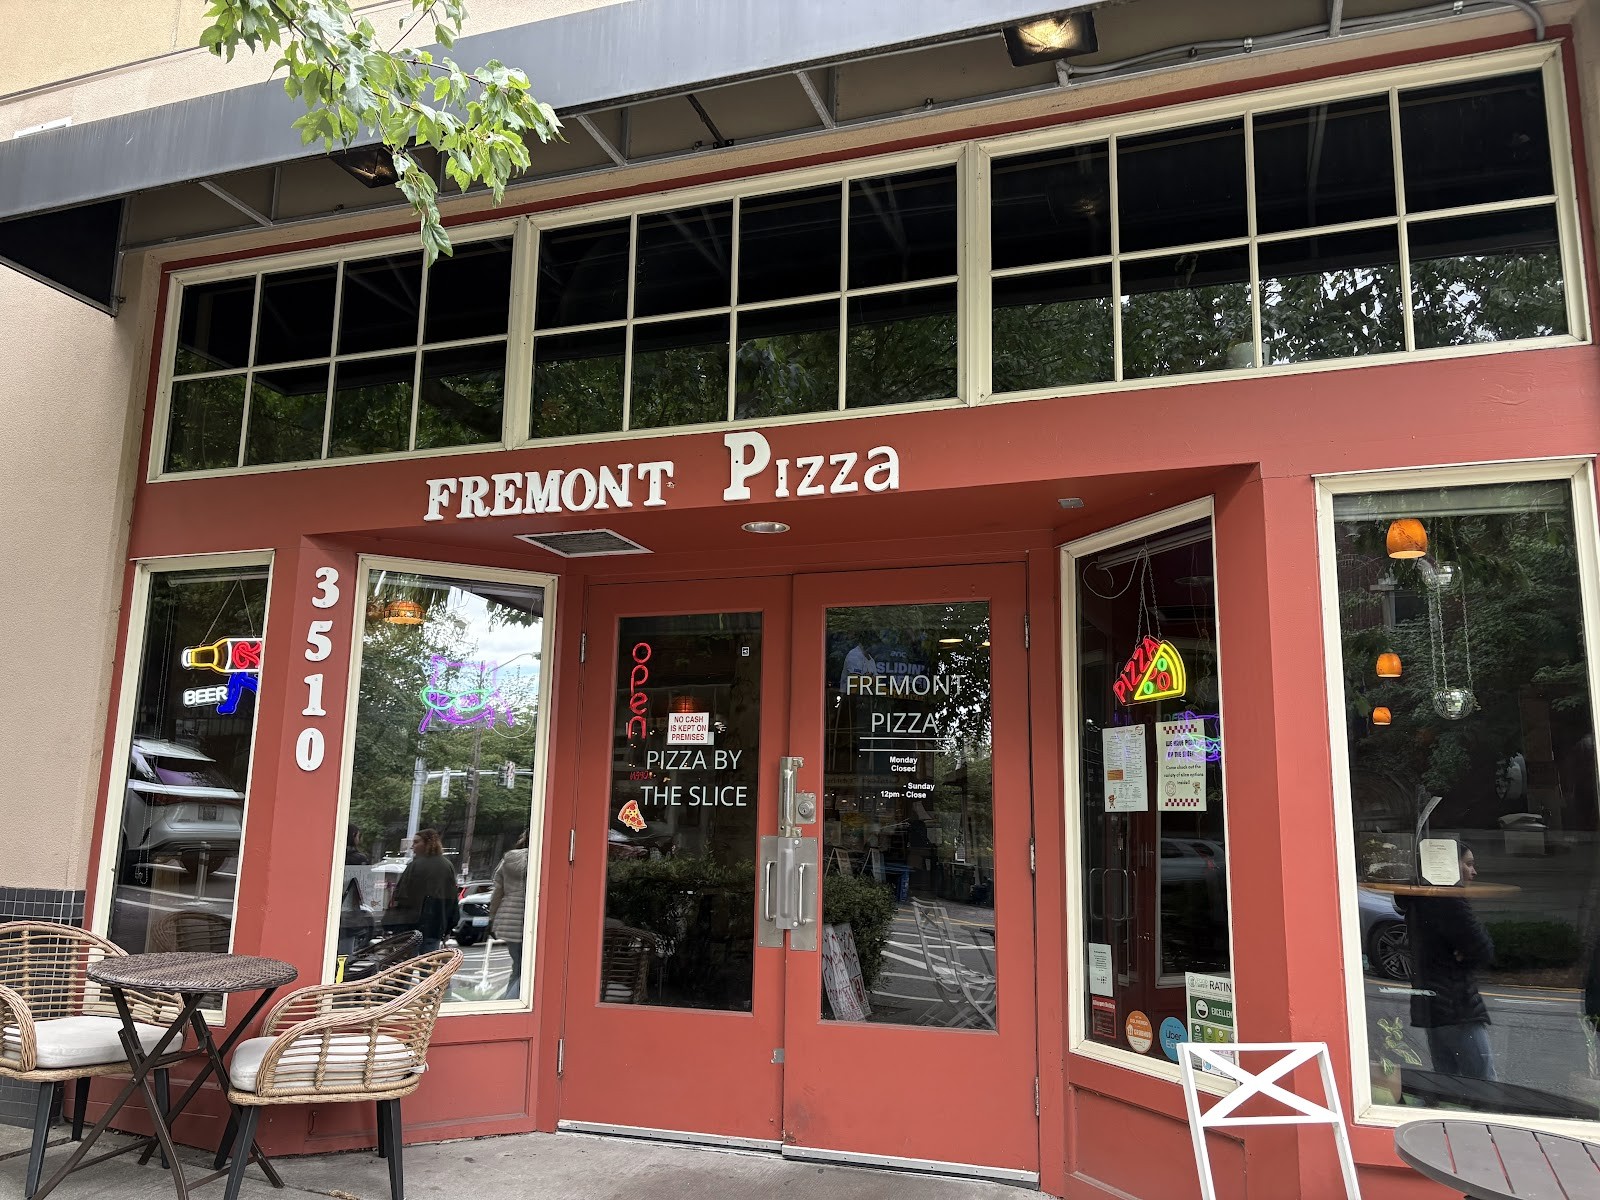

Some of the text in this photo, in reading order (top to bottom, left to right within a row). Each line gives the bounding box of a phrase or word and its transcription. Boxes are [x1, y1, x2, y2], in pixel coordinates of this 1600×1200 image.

[423, 460, 674, 521] FREMONT
[296, 567, 340, 771] 3510
[846, 674, 967, 697] FREMONT
[184, 685, 228, 706] BEER
[674, 715, 704, 723] NO CASH
[871, 712, 940, 734] PIZZA
[670, 724, 707, 732] IS KEPT ON
[671, 733, 705, 741] PREMISES
[646, 750, 742, 770] PIZZA BY
[889, 755, 918, 765] Monday
[891, 764, 916, 773] Closed
[907, 782, 935, 792] Sunday
[640, 785, 747, 807] THE SLICE
[880, 790, 900, 800] 12pm
[905, 791, 927, 799] Close
[1209, 980, 1232, 993] RATIN
[1211, 1007, 1233, 1019] EXCELLEN
[1165, 1029, 1182, 1041] Uber
